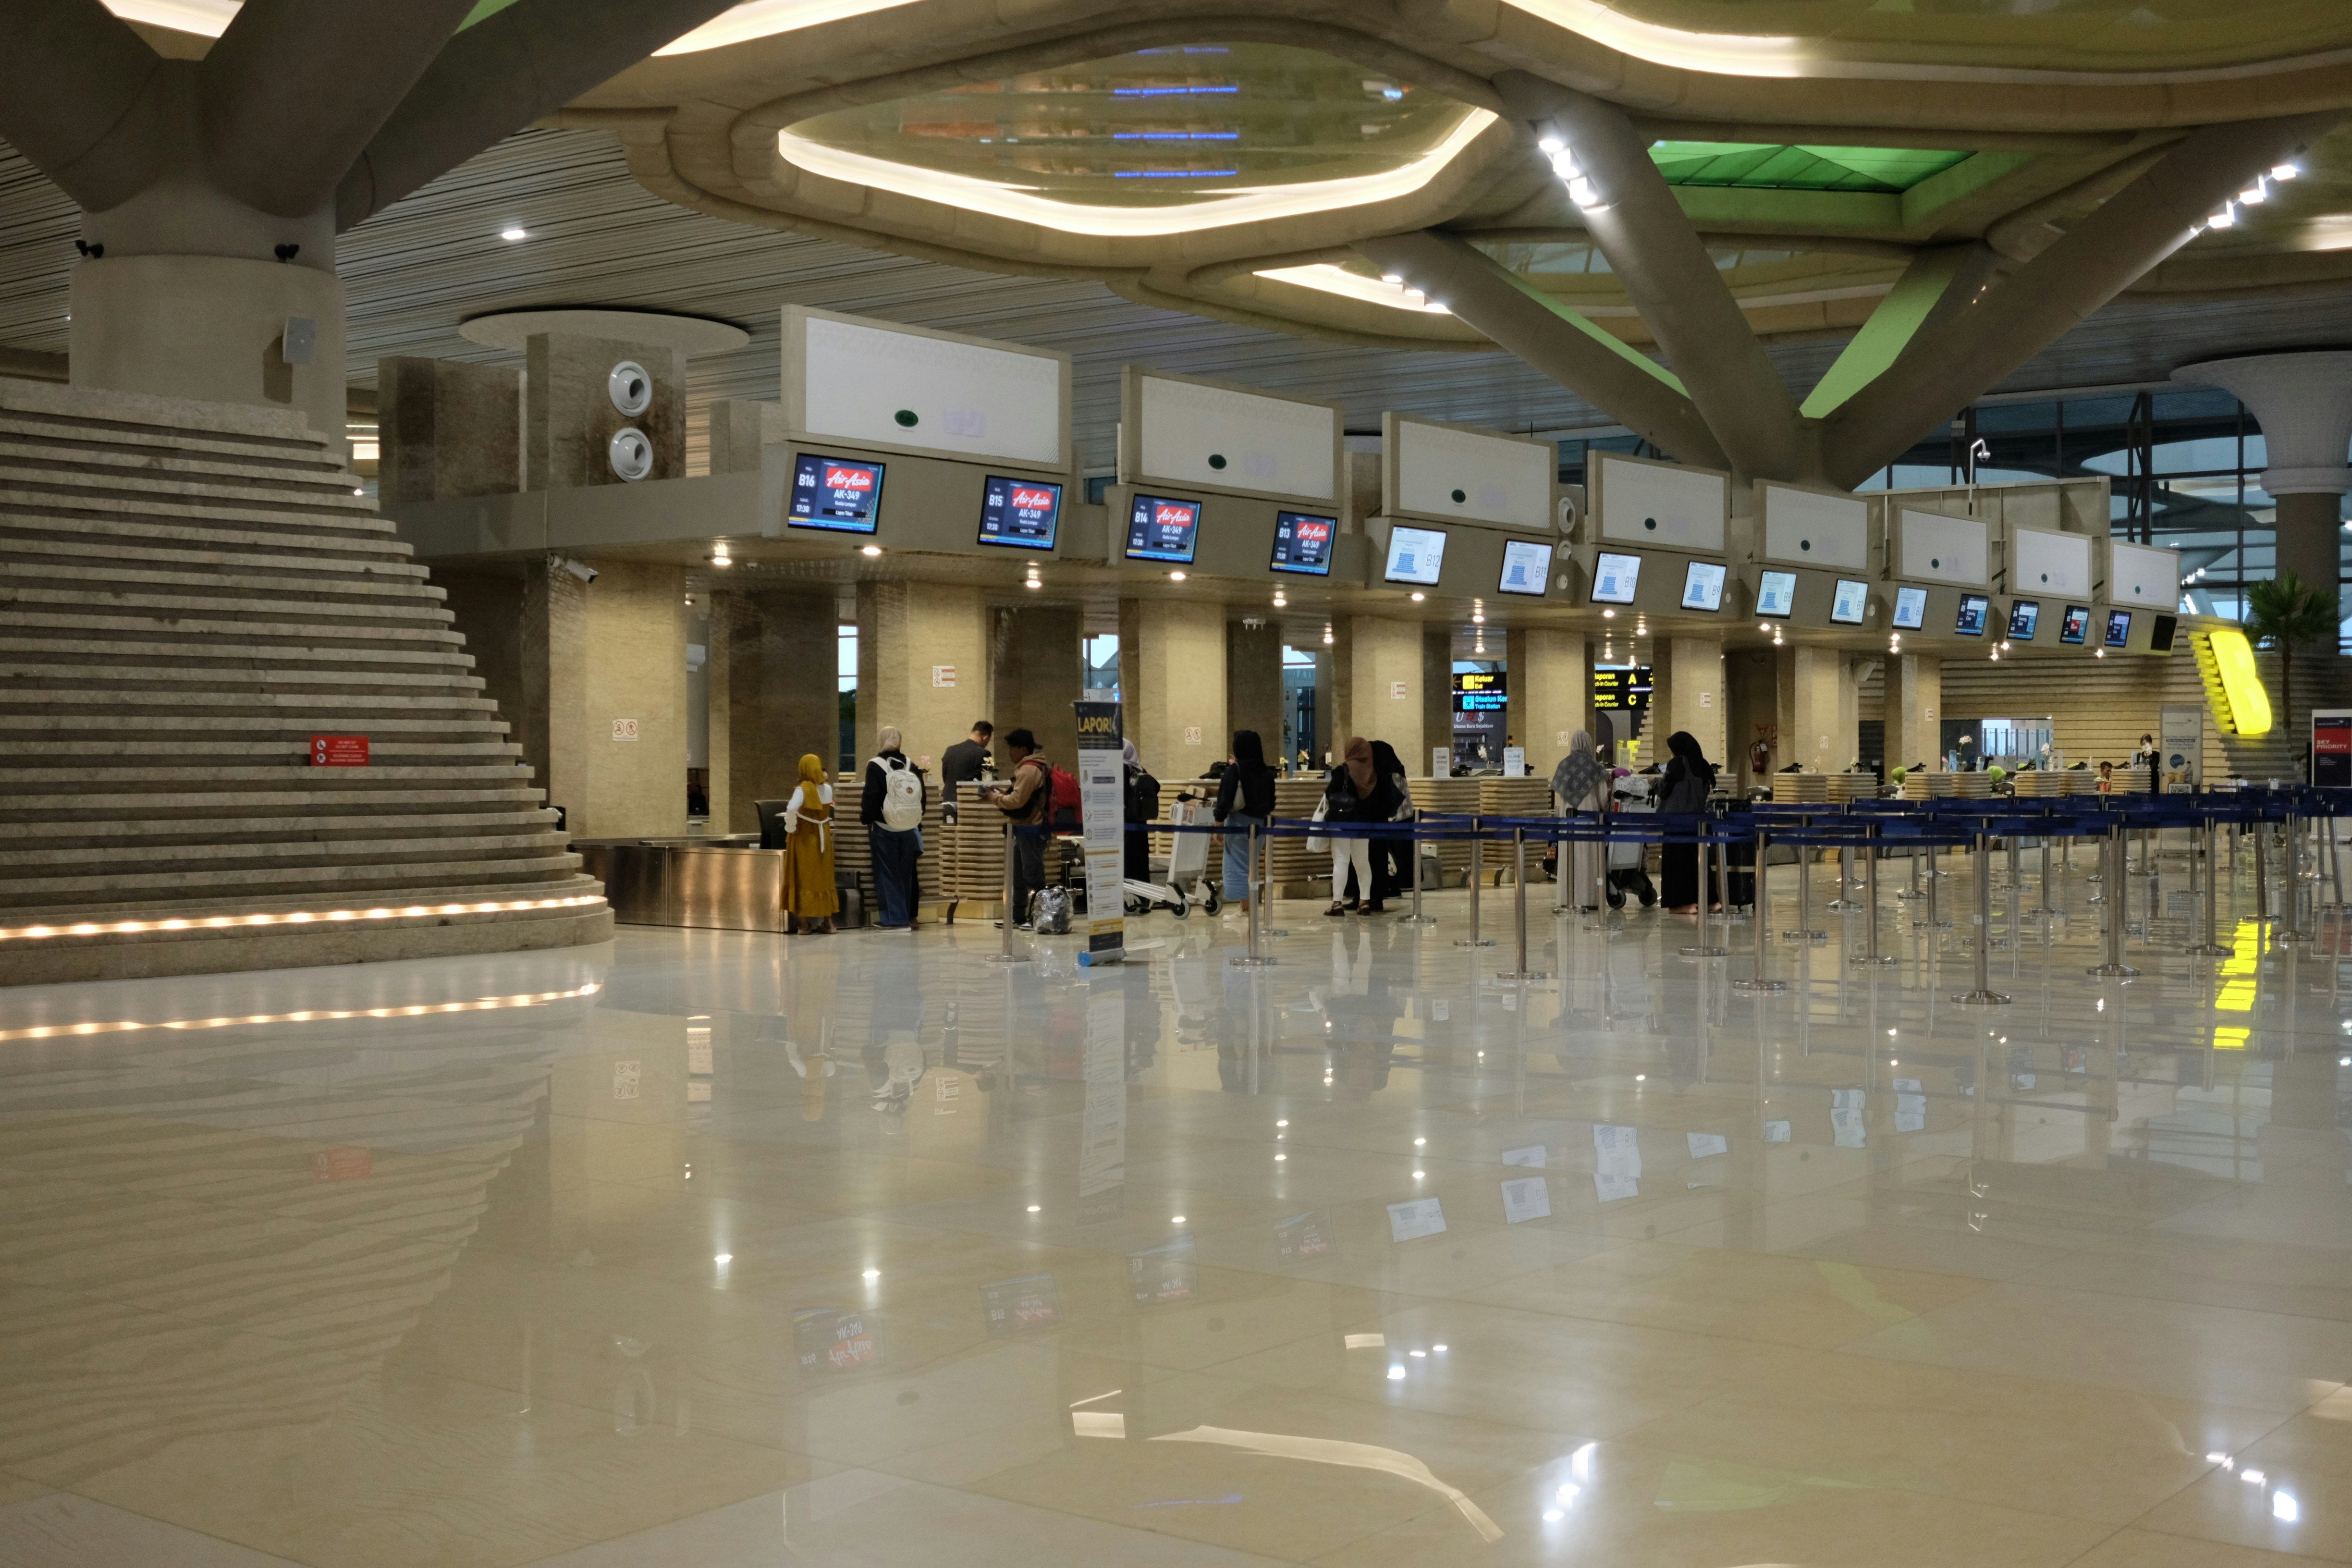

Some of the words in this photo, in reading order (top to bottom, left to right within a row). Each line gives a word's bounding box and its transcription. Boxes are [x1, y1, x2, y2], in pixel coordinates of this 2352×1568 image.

[798, 474, 815, 488] B16
[833, 489, 860, 500] AK-349
[989, 494, 1003, 507] B15
[1018, 508, 1041, 518] AK-349
[1135, 512, 1148, 524] B14
[1162, 525, 1182, 535] AK-349
[1279, 527, 1290, 539] B13
[1302, 539, 1320, 549] AK-349
[1426, 554, 1440, 567] B12
[1535, 566, 1546, 578] B11
[1624, 576, 1636, 588] B10
[1712, 585, 1720, 596] B9
[1784, 592, 1791, 602] B8
[1857, 600, 1863, 610] B7
[1628, 673, 1637, 685] A
[1628, 694, 1637, 706] C
[1078, 716, 1112, 733] LAPOR!
